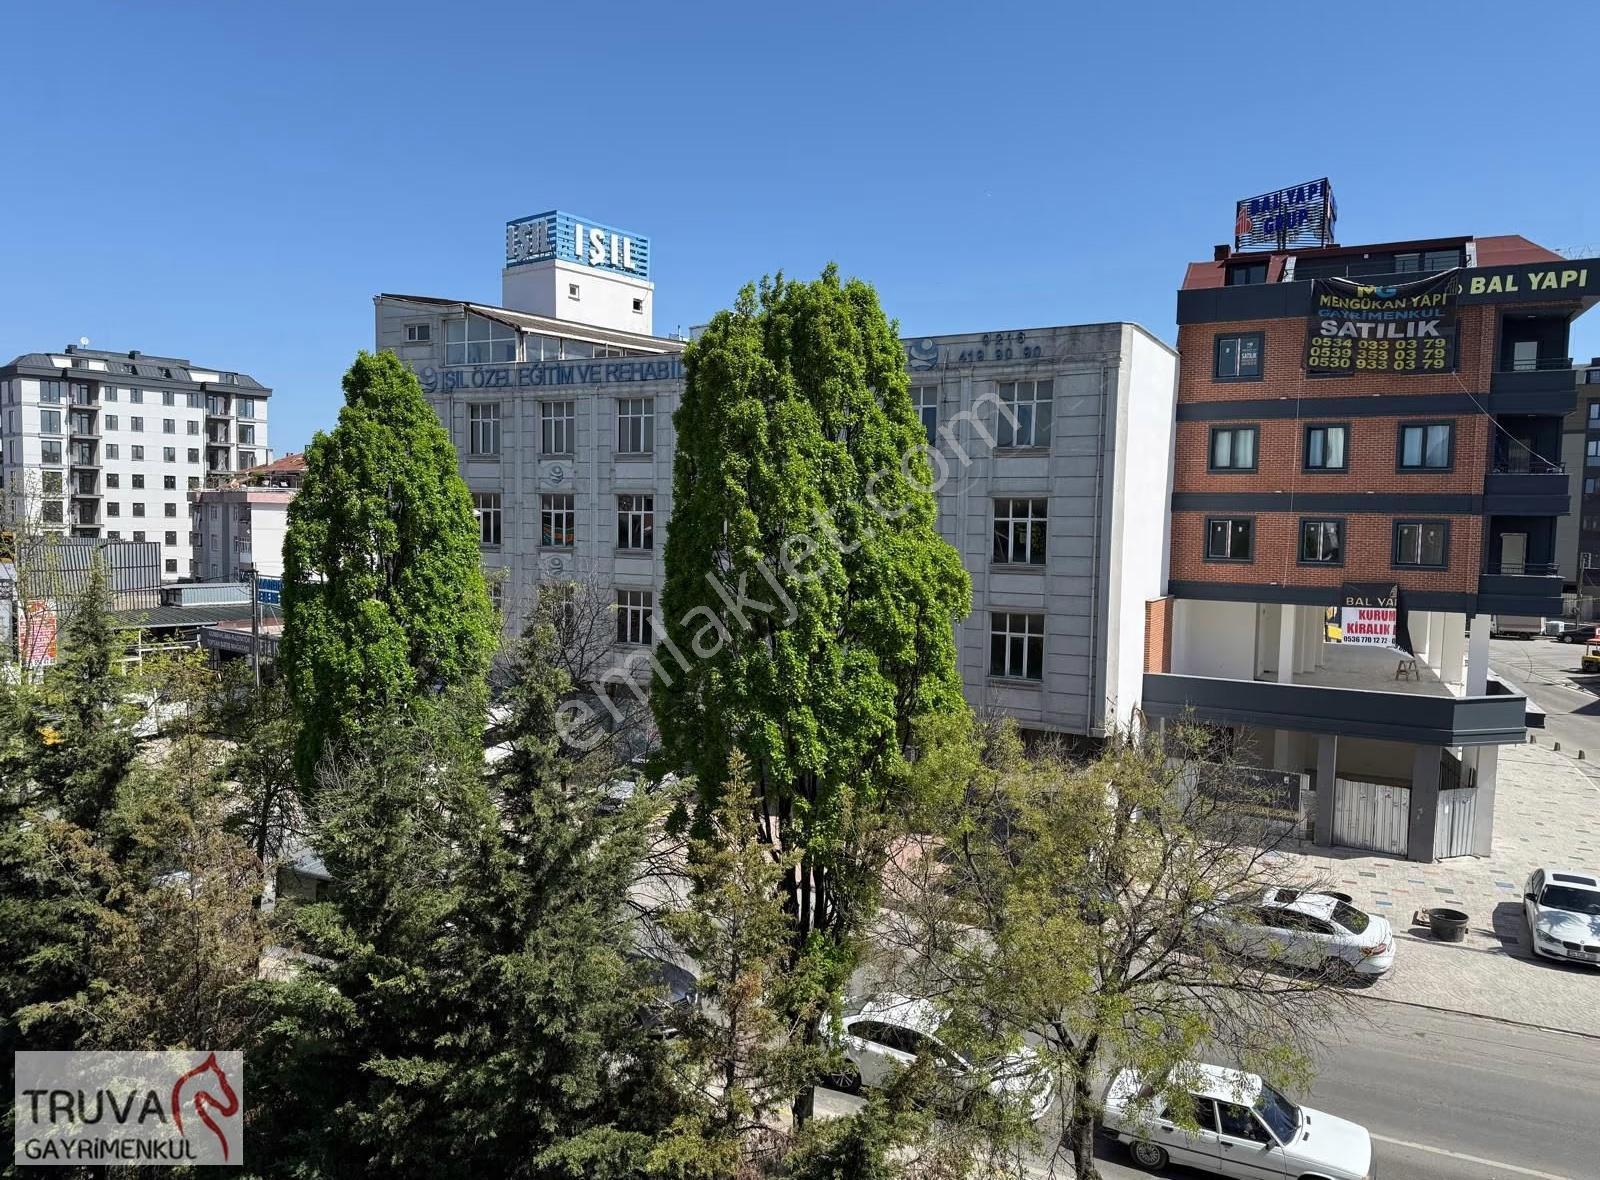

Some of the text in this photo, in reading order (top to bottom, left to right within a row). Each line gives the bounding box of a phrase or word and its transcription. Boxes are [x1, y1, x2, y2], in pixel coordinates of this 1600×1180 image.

[1263, 207, 1309, 235] GRUP
[574, 223, 636, 271] IŞIL
[1470, 269, 1587, 295] BAL YAPI
[1319, 293, 1447, 310] MENGÜKAN YAPI
[1320, 320, 1441, 339] SATILIK
[1311, 337, 1446, 350] 0534 033 03 79
[1310, 347, 1445, 360] 0539 353 03 79
[1309, 357, 1444, 370] 0530 933 03 79
[472, 366, 513, 388] ÖZEL
[518, 363, 575, 387] EĞİTİM
[577, 365, 601, 383] VE
[1346, 597, 1373, 606] BAL
